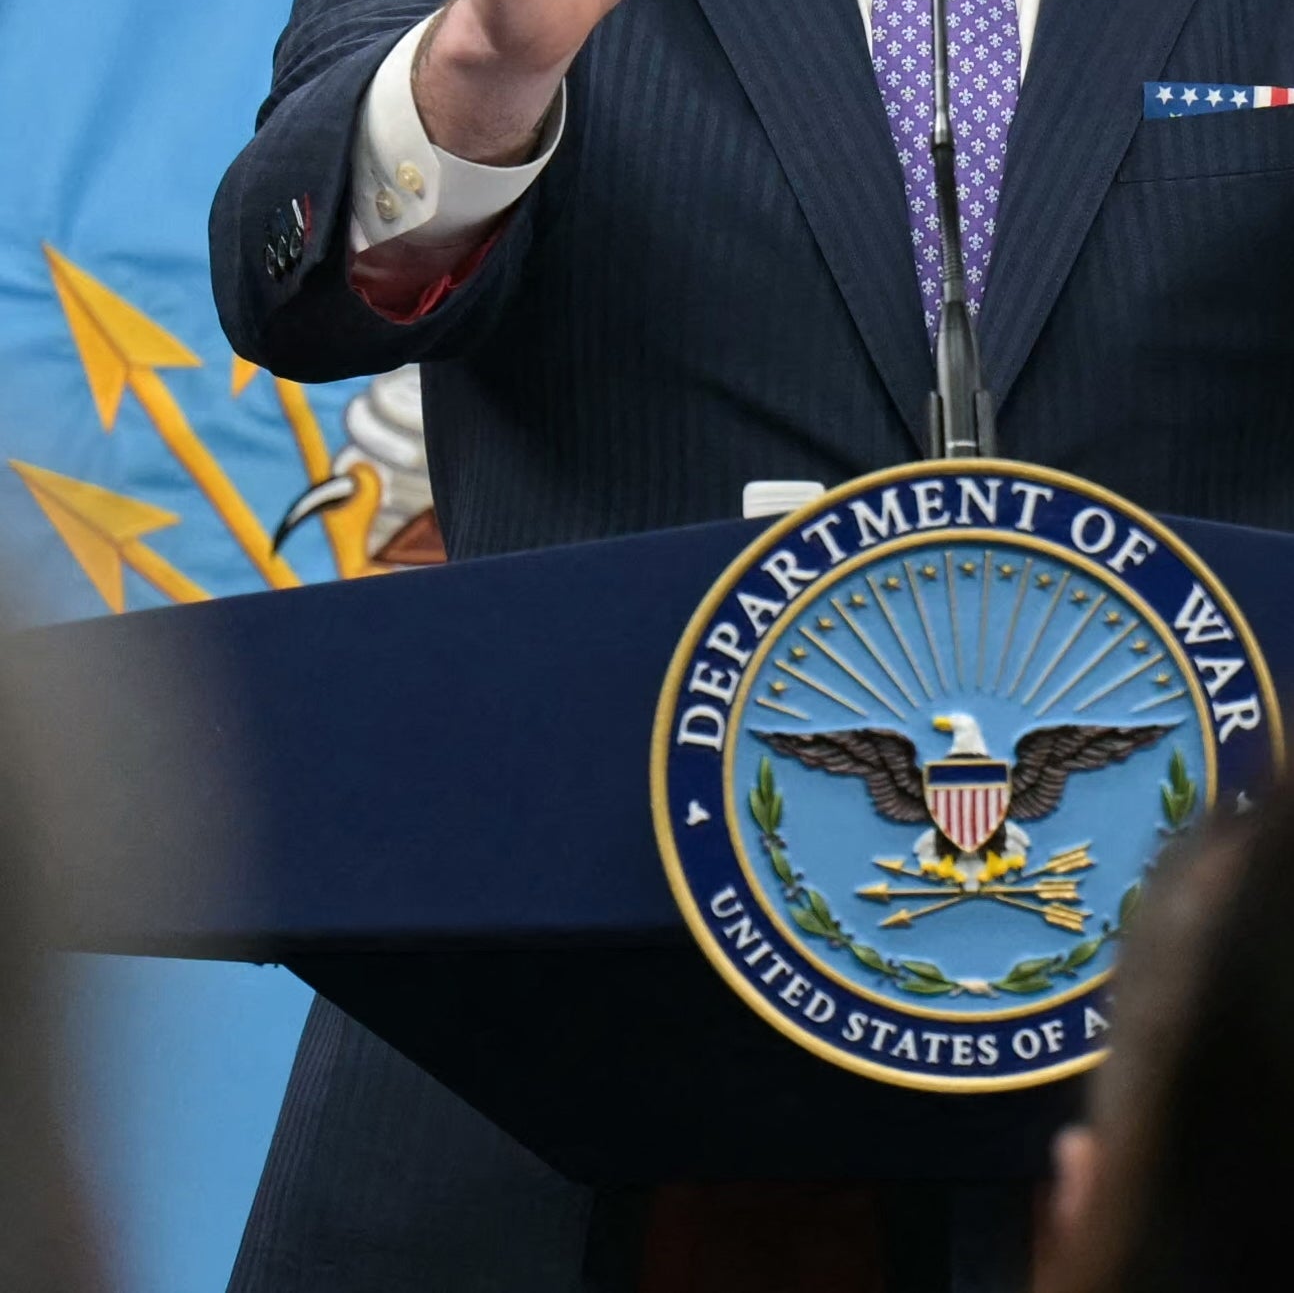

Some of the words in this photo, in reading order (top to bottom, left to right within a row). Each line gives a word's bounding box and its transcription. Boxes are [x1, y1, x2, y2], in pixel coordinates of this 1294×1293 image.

[678, 478, 1053, 752] DEPARTMENT
[1071, 508, 1156, 573] OF
[1174, 584, 1261, 743] WAR
[711, 888, 836, 1024] UNITED
[842, 1012, 999, 1066] STATES
[1013, 1022, 1065, 1059] OF
